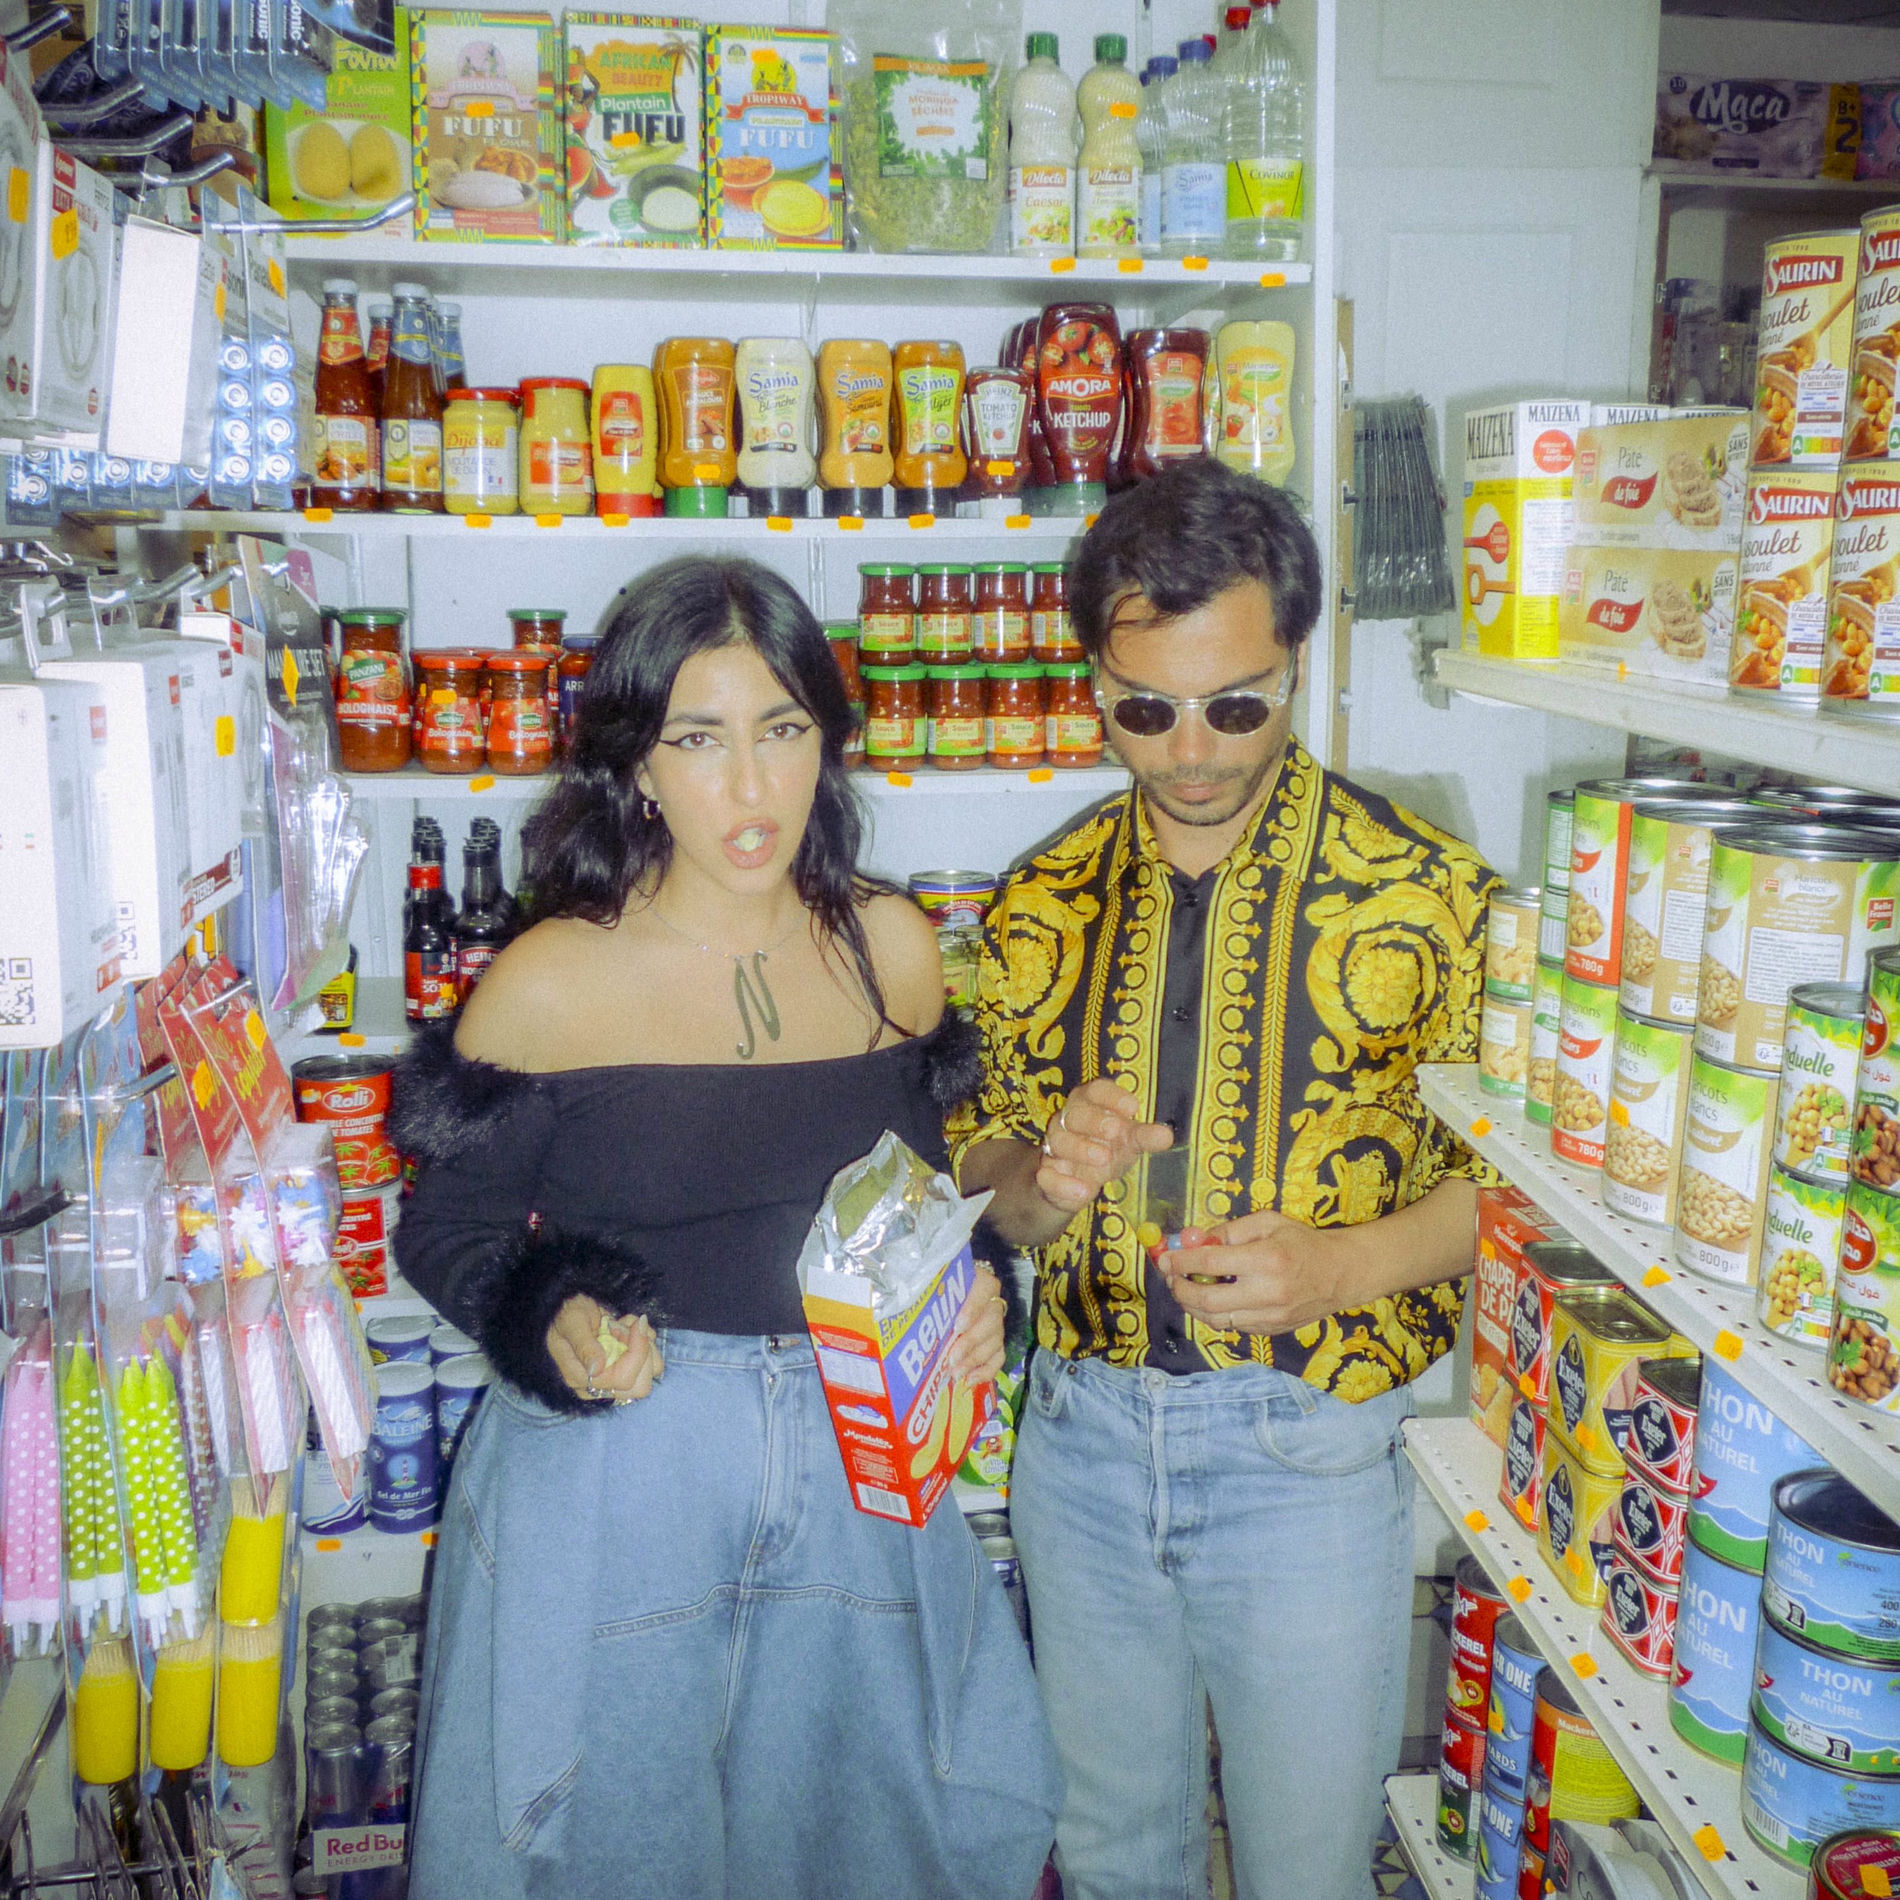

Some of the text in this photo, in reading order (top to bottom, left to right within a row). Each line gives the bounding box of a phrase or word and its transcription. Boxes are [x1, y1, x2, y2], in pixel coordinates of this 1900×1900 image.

[601, 52, 672, 70] AFRICAN
[601, 94, 666, 111] Plantain
[746, 92, 805, 105] TROPIWAY
[1696, 83, 1790, 134] Maca
[443, 116, 522, 137] FUFU
[602, 112, 685, 145] FUFU
[1835, 117, 1858, 153] 2
[740, 128, 815, 149] FUFU
[1766, 255, 1836, 298] SAURIN
[749, 371, 799, 394] Samia
[837, 373, 884, 395] Samia
[906, 373, 955, 396] Samia
[1049, 377, 1112, 397] AMORA
[1053, 412, 1111, 429] KETCHUP
[1528, 405, 1580, 422] MAIZENA
[1466, 411, 1514, 460] MAIZENA
[1728, 438, 1748, 453] SANS
[1750, 483, 1830, 525] SAURIN
[1714, 574, 1734, 588] SANS
[349, 662, 386, 680] PANZANI
[1578, 1142, 1604, 1160] 780g
[1710, 1420, 1733, 1442] AU
[1776, 1520, 1824, 1565] THON
[1505, 1661, 1532, 1694] ONE
[1800, 1658, 1873, 1697] THON
[1490, 1809, 1514, 1838] ONE
[327, 1835, 371, 1857] Red
